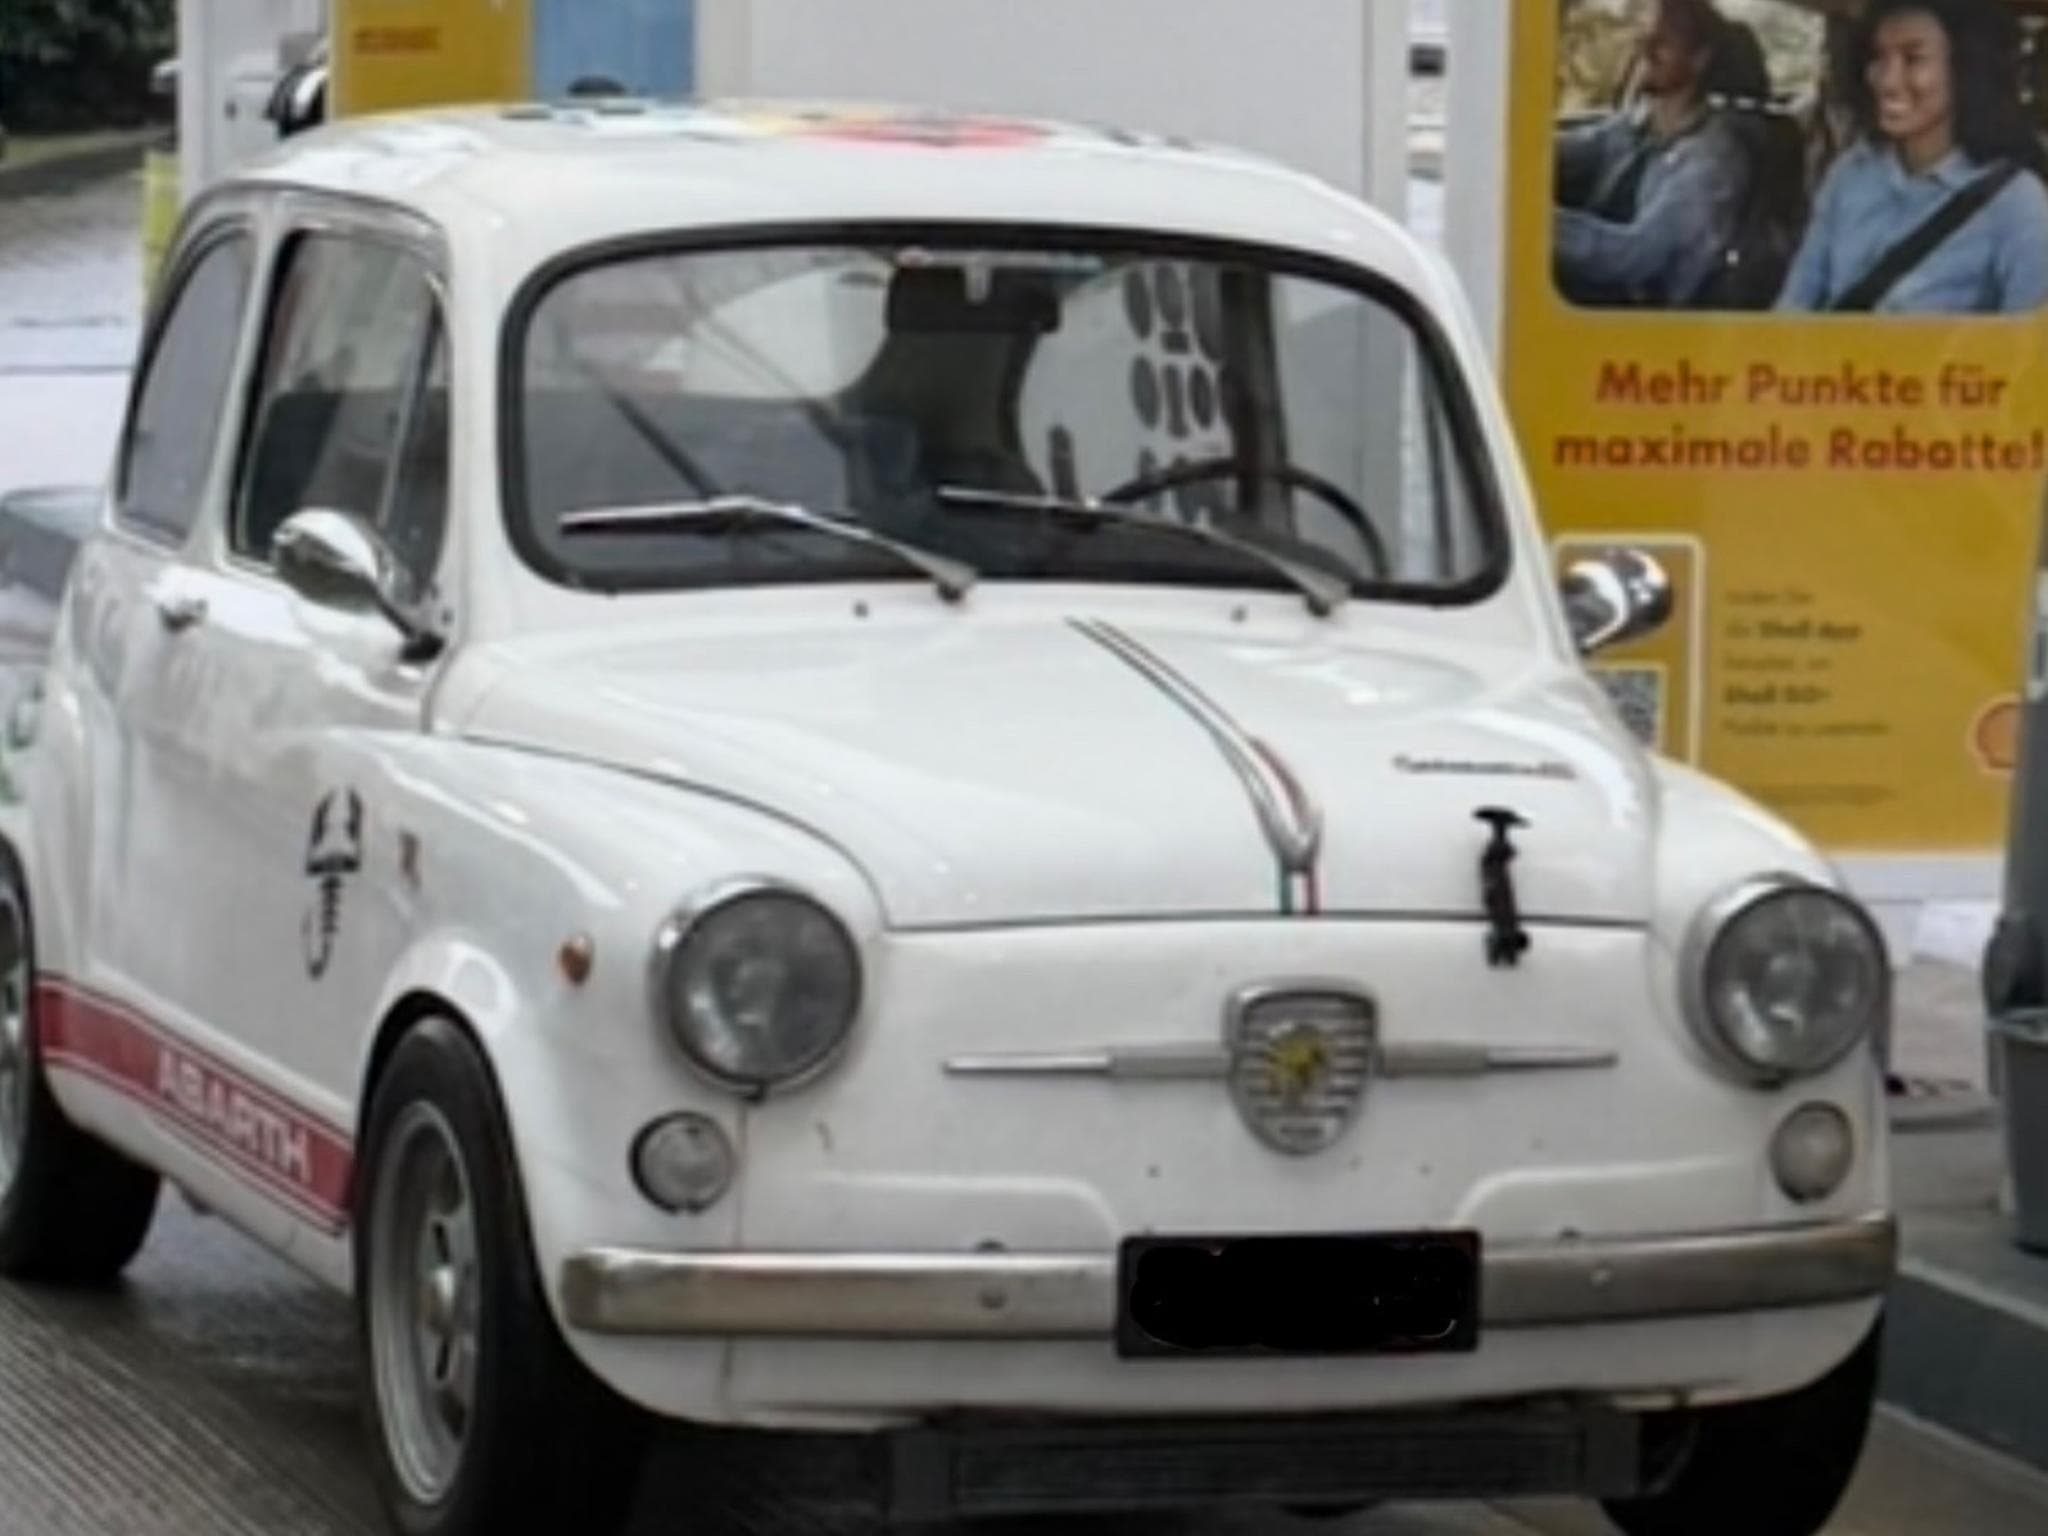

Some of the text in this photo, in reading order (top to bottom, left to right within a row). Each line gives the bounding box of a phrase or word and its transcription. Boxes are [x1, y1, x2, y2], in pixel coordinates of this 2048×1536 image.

[1596, 358, 2008, 406] Mehr Punkte für
[1553, 424, 2044, 471] maximale Rabatte!
[157, 1046, 313, 1184] ABARTH
